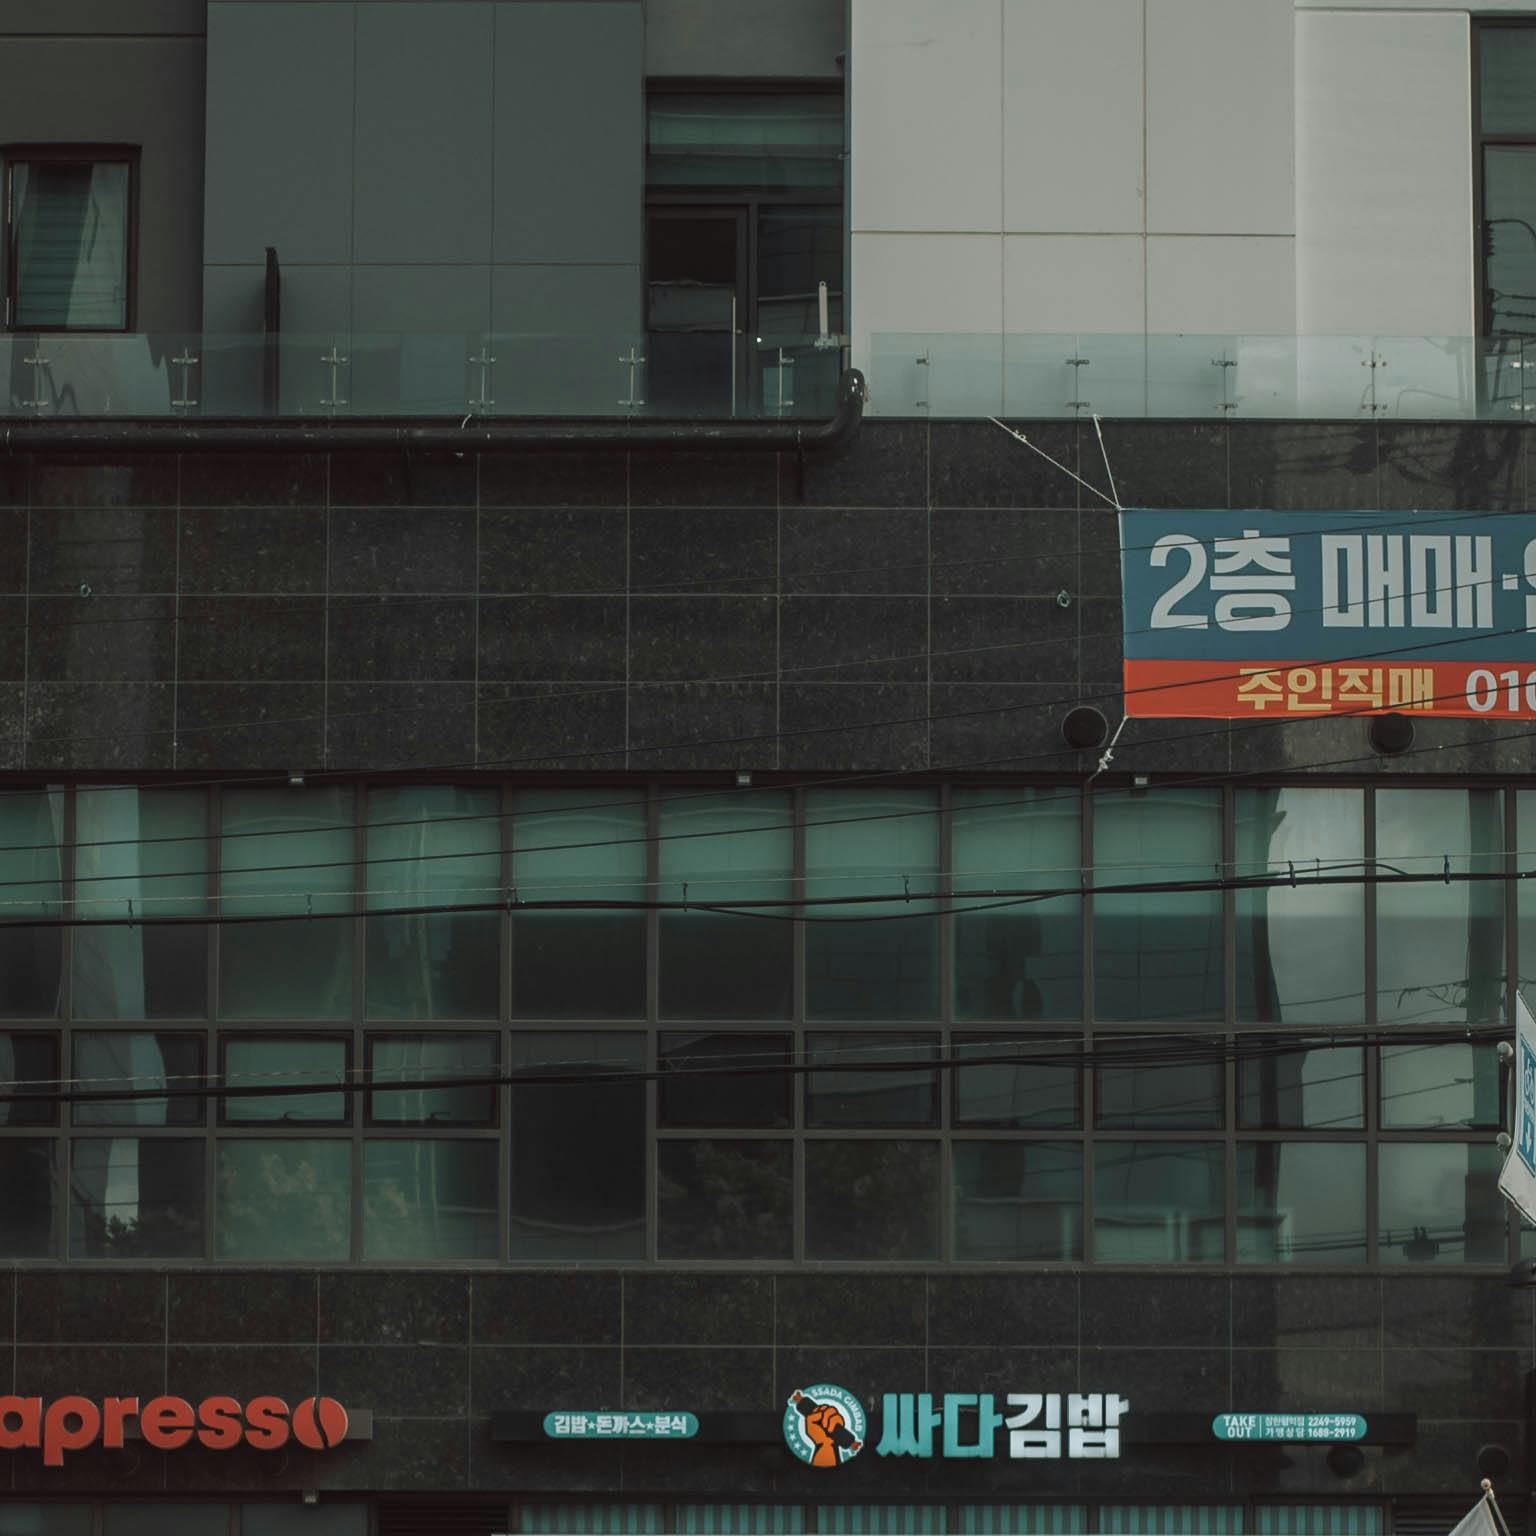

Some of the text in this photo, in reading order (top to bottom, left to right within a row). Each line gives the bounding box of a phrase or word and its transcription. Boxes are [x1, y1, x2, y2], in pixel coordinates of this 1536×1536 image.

[1150, 530, 1296, 632] 2층
[1237, 667, 1434, 711] 주인직매
[811, 1387, 843, 1399] SSADA
[554, 1414, 588, 1434] 김밥
[595, 1414, 646, 1434] 돈까스
[875, 1393, 1130, 1458] 싸다김밥
[1223, 1415, 1256, 1427] TAKE
[1227, 1427, 1252, 1438] OUT
